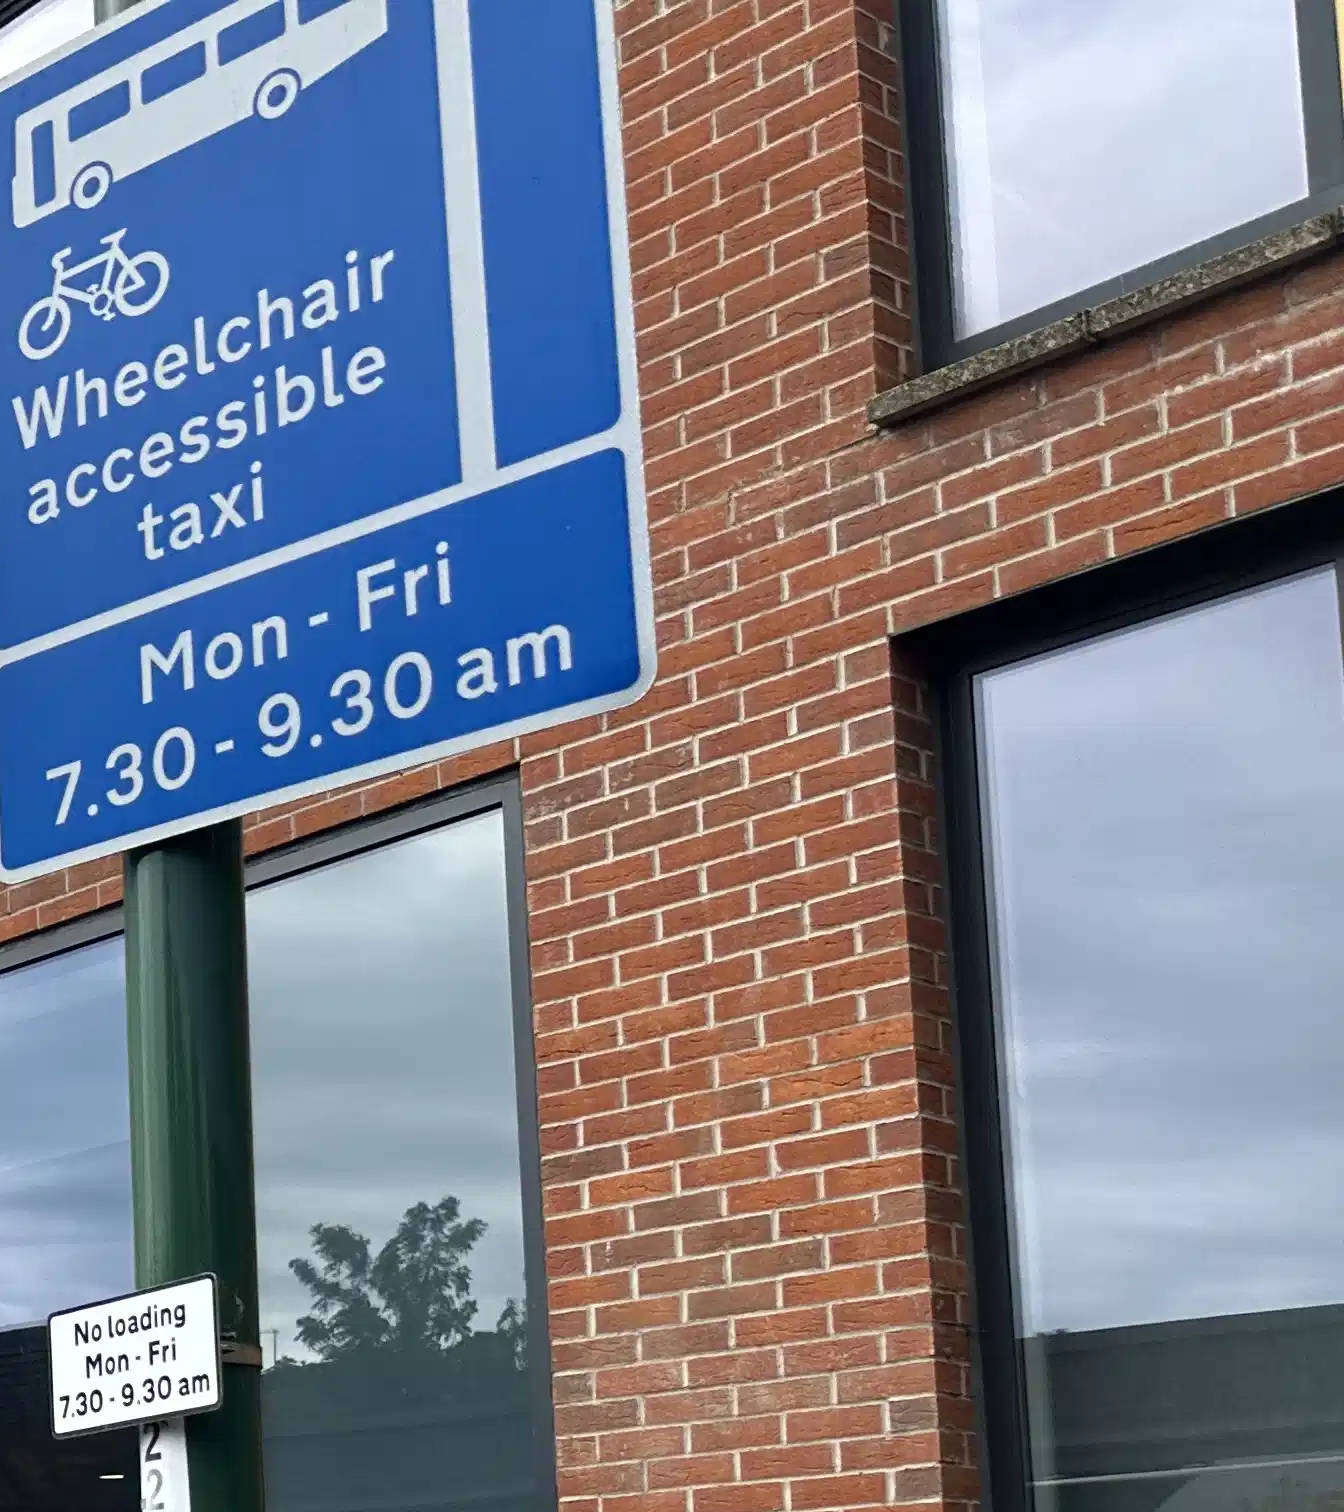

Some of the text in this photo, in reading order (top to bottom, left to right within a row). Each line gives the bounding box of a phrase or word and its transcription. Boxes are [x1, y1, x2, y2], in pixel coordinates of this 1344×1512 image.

[12, 249, 396, 450] Wheelchair
[27, 344, 387, 526] accessible
[137, 461, 266, 561] taxi
[139, 614, 289, 704] Mon
[356, 541, 452, 632] Fri
[45, 726, 196, 826] 7.30
[257, 651, 433, 759] 9.30
[455, 623, 573, 700] am
[74, 1304, 186, 1347] No loading
[85, 1353, 129, 1379] Mon
[148, 1337, 176, 1366] Fri
[59, 1389, 103, 1419] 7.30
[121, 1375, 172, 1407] 9.30
[178, 1373, 210, 1397] am
